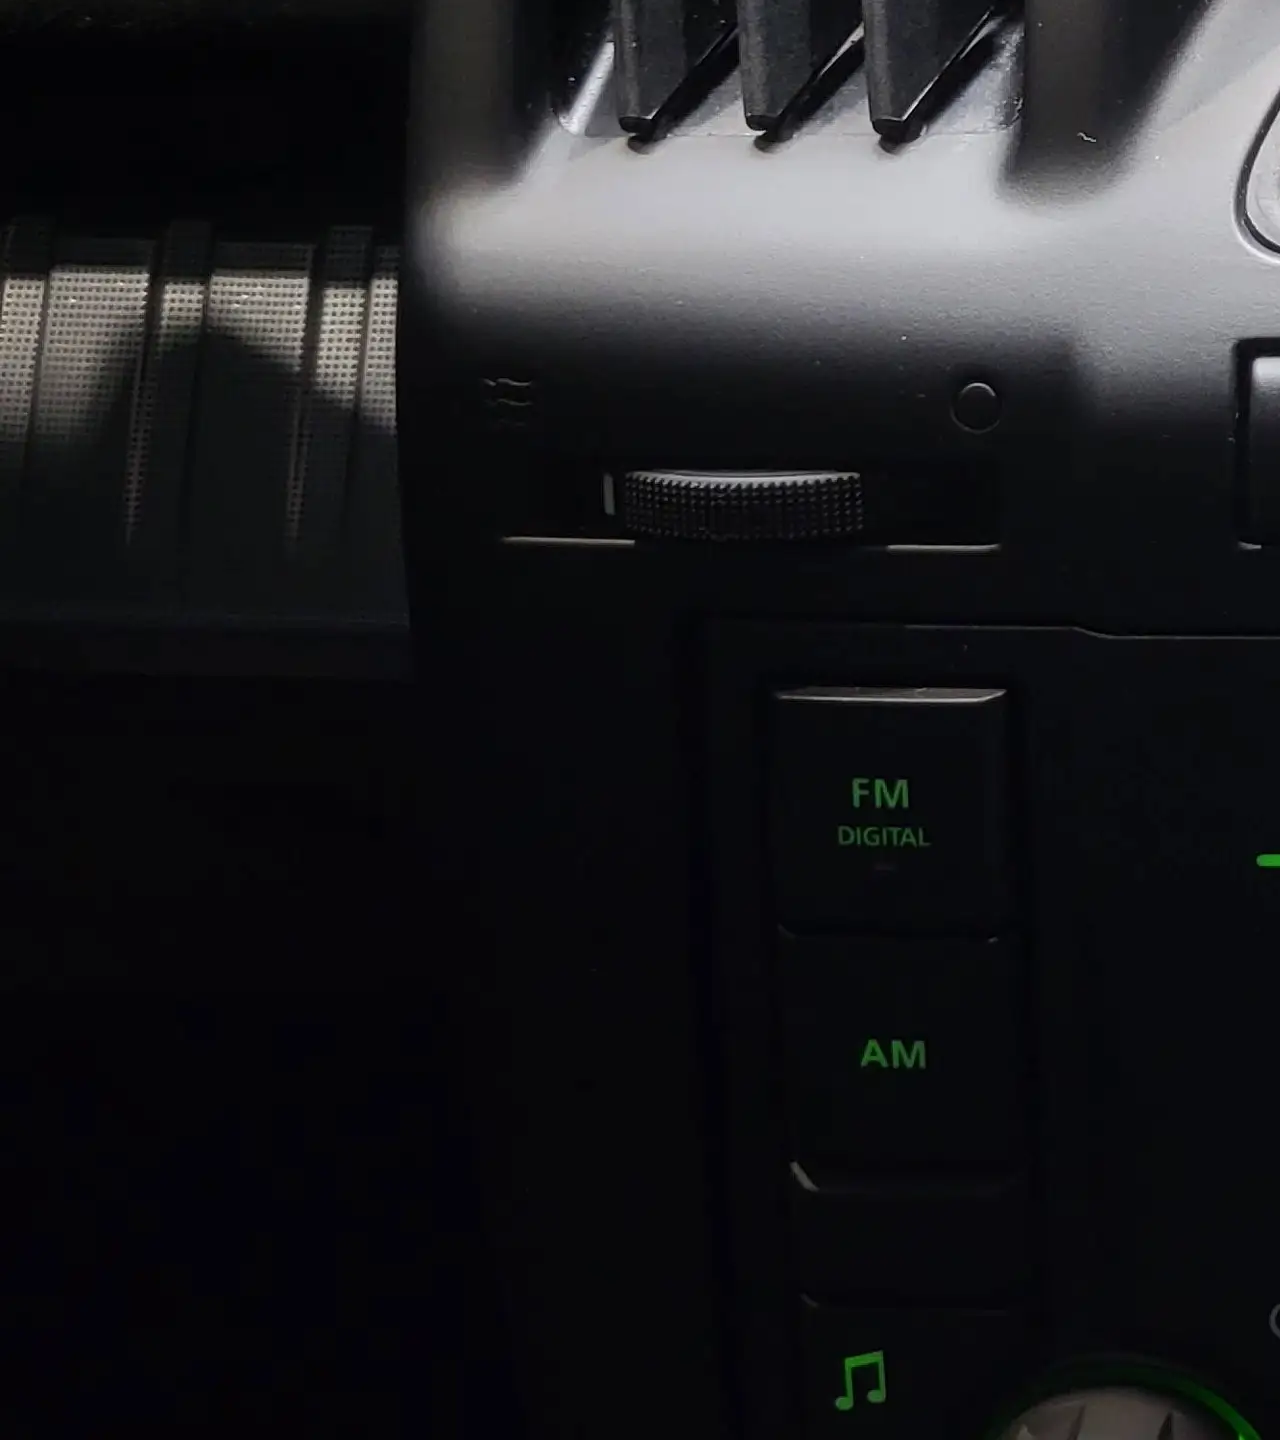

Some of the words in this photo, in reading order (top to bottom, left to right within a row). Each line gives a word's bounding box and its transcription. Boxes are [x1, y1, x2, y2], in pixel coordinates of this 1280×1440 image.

[852, 778, 909, 809] FM
[838, 825, 930, 847] DIGITAL
[860, 1040, 926, 1069] AM
